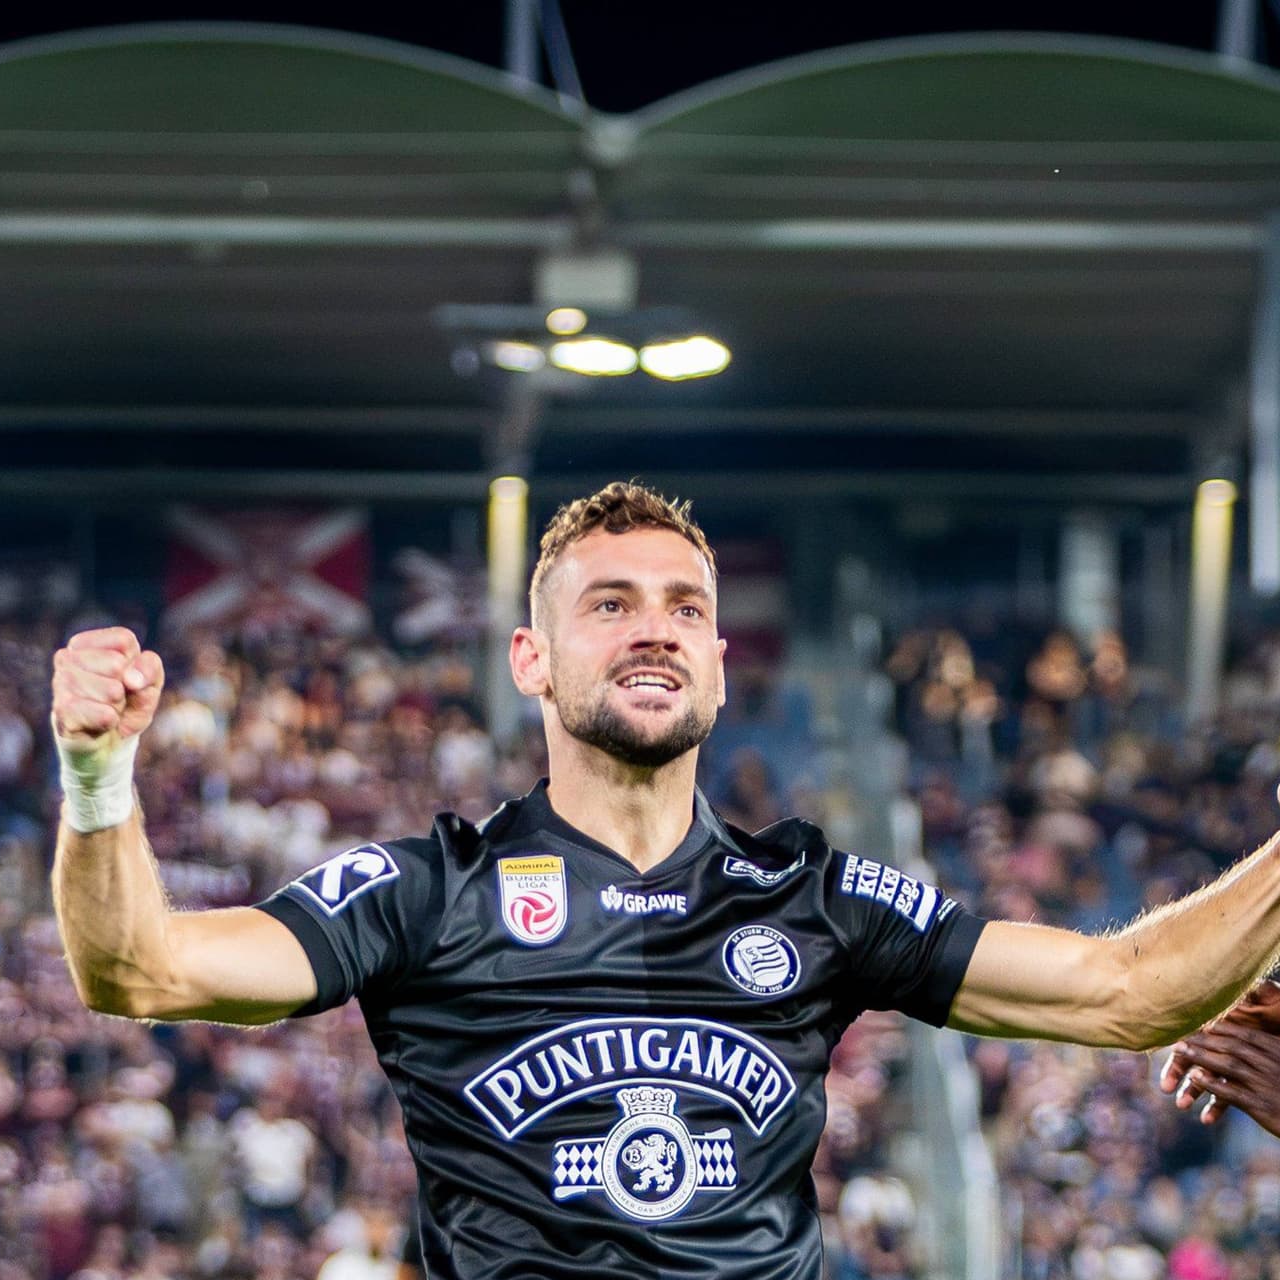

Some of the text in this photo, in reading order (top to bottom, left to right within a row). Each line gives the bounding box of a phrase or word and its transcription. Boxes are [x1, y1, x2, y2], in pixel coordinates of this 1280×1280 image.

[505, 874, 559, 882] BUNDES
[624, 894, 687, 915] GRAWE
[485, 1028, 782, 1120] PUNTIGAMER
